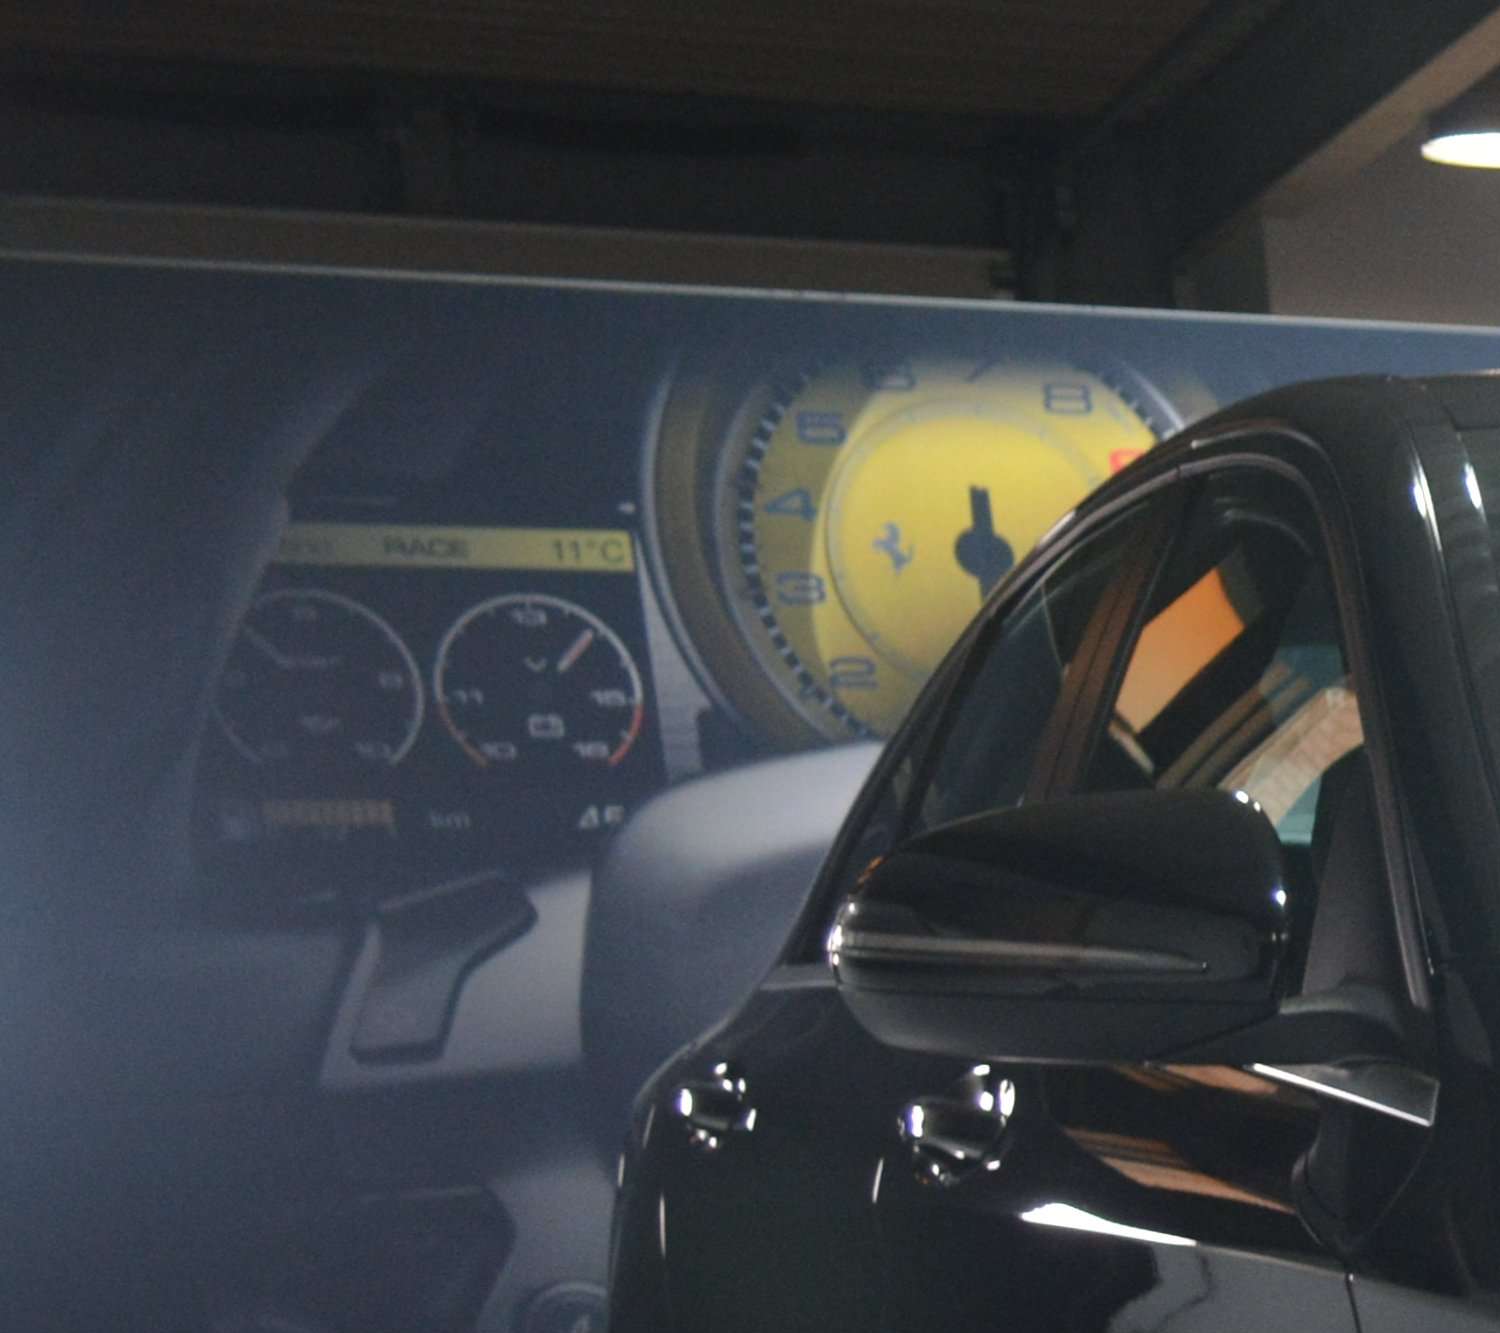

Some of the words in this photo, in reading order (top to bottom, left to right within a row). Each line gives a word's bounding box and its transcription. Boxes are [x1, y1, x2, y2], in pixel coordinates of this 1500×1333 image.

[1043, 383, 1092, 416] 8
[763, 486, 818, 522] 4
[775, 571, 826, 606] 3
[828, 656, 877, 690] 2
